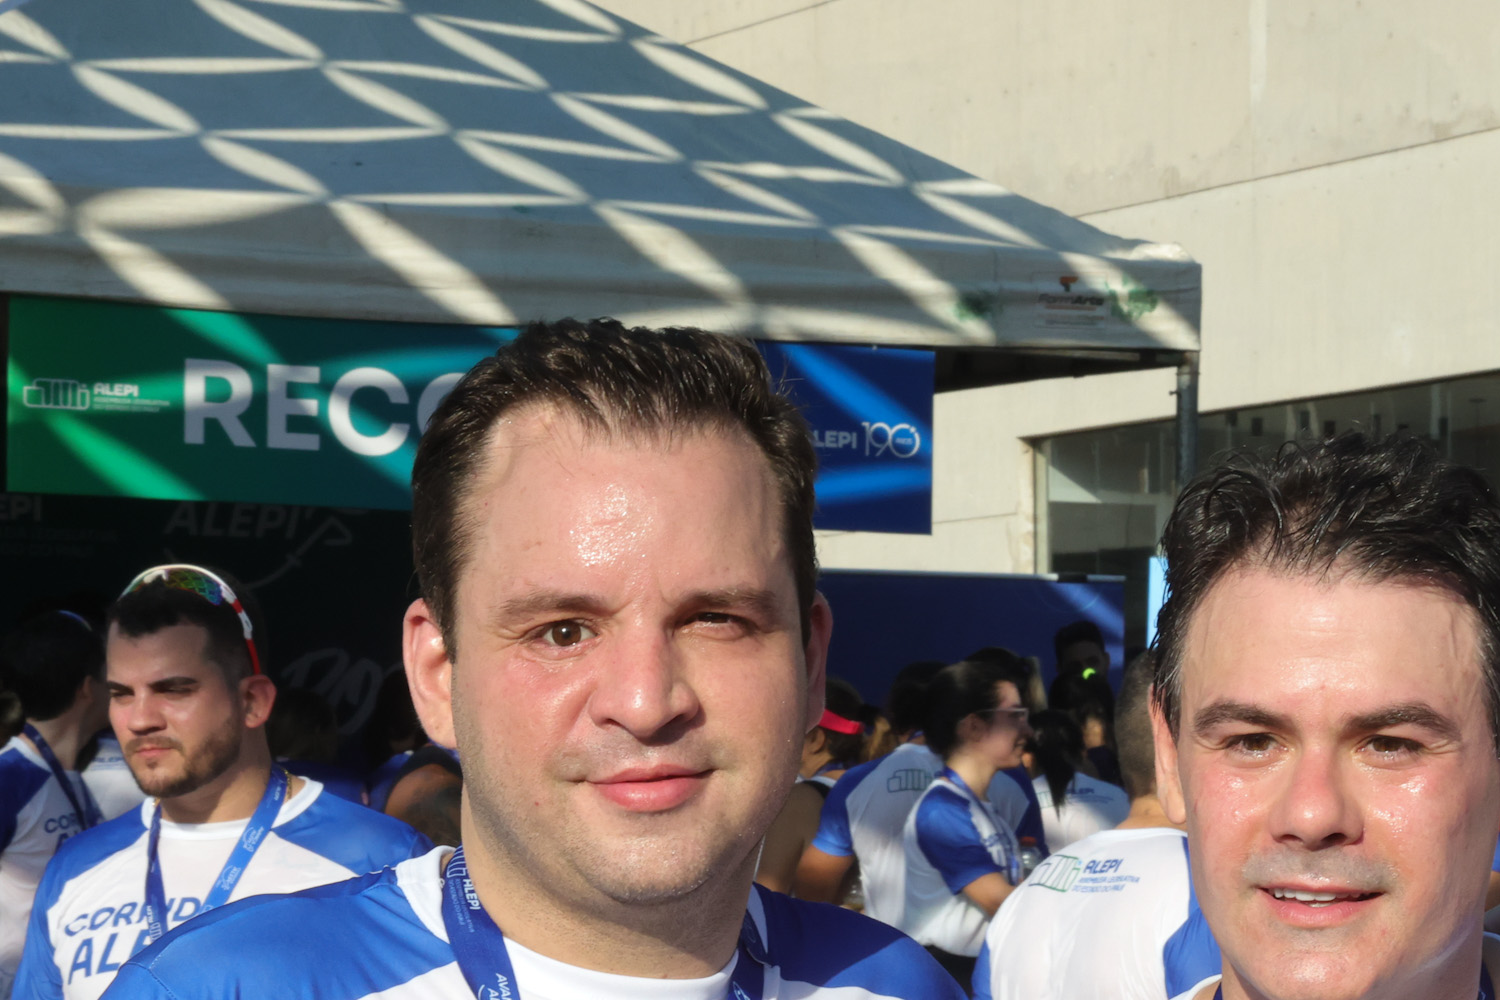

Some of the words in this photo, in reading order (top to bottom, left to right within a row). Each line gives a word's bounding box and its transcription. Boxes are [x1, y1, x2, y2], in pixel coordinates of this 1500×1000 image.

[93, 382, 139, 398] ALEPI
[812, 430, 858, 450] LEPI
[164, 500, 301, 541] ALEPI
[1083, 858, 1124, 874] ALEPI
